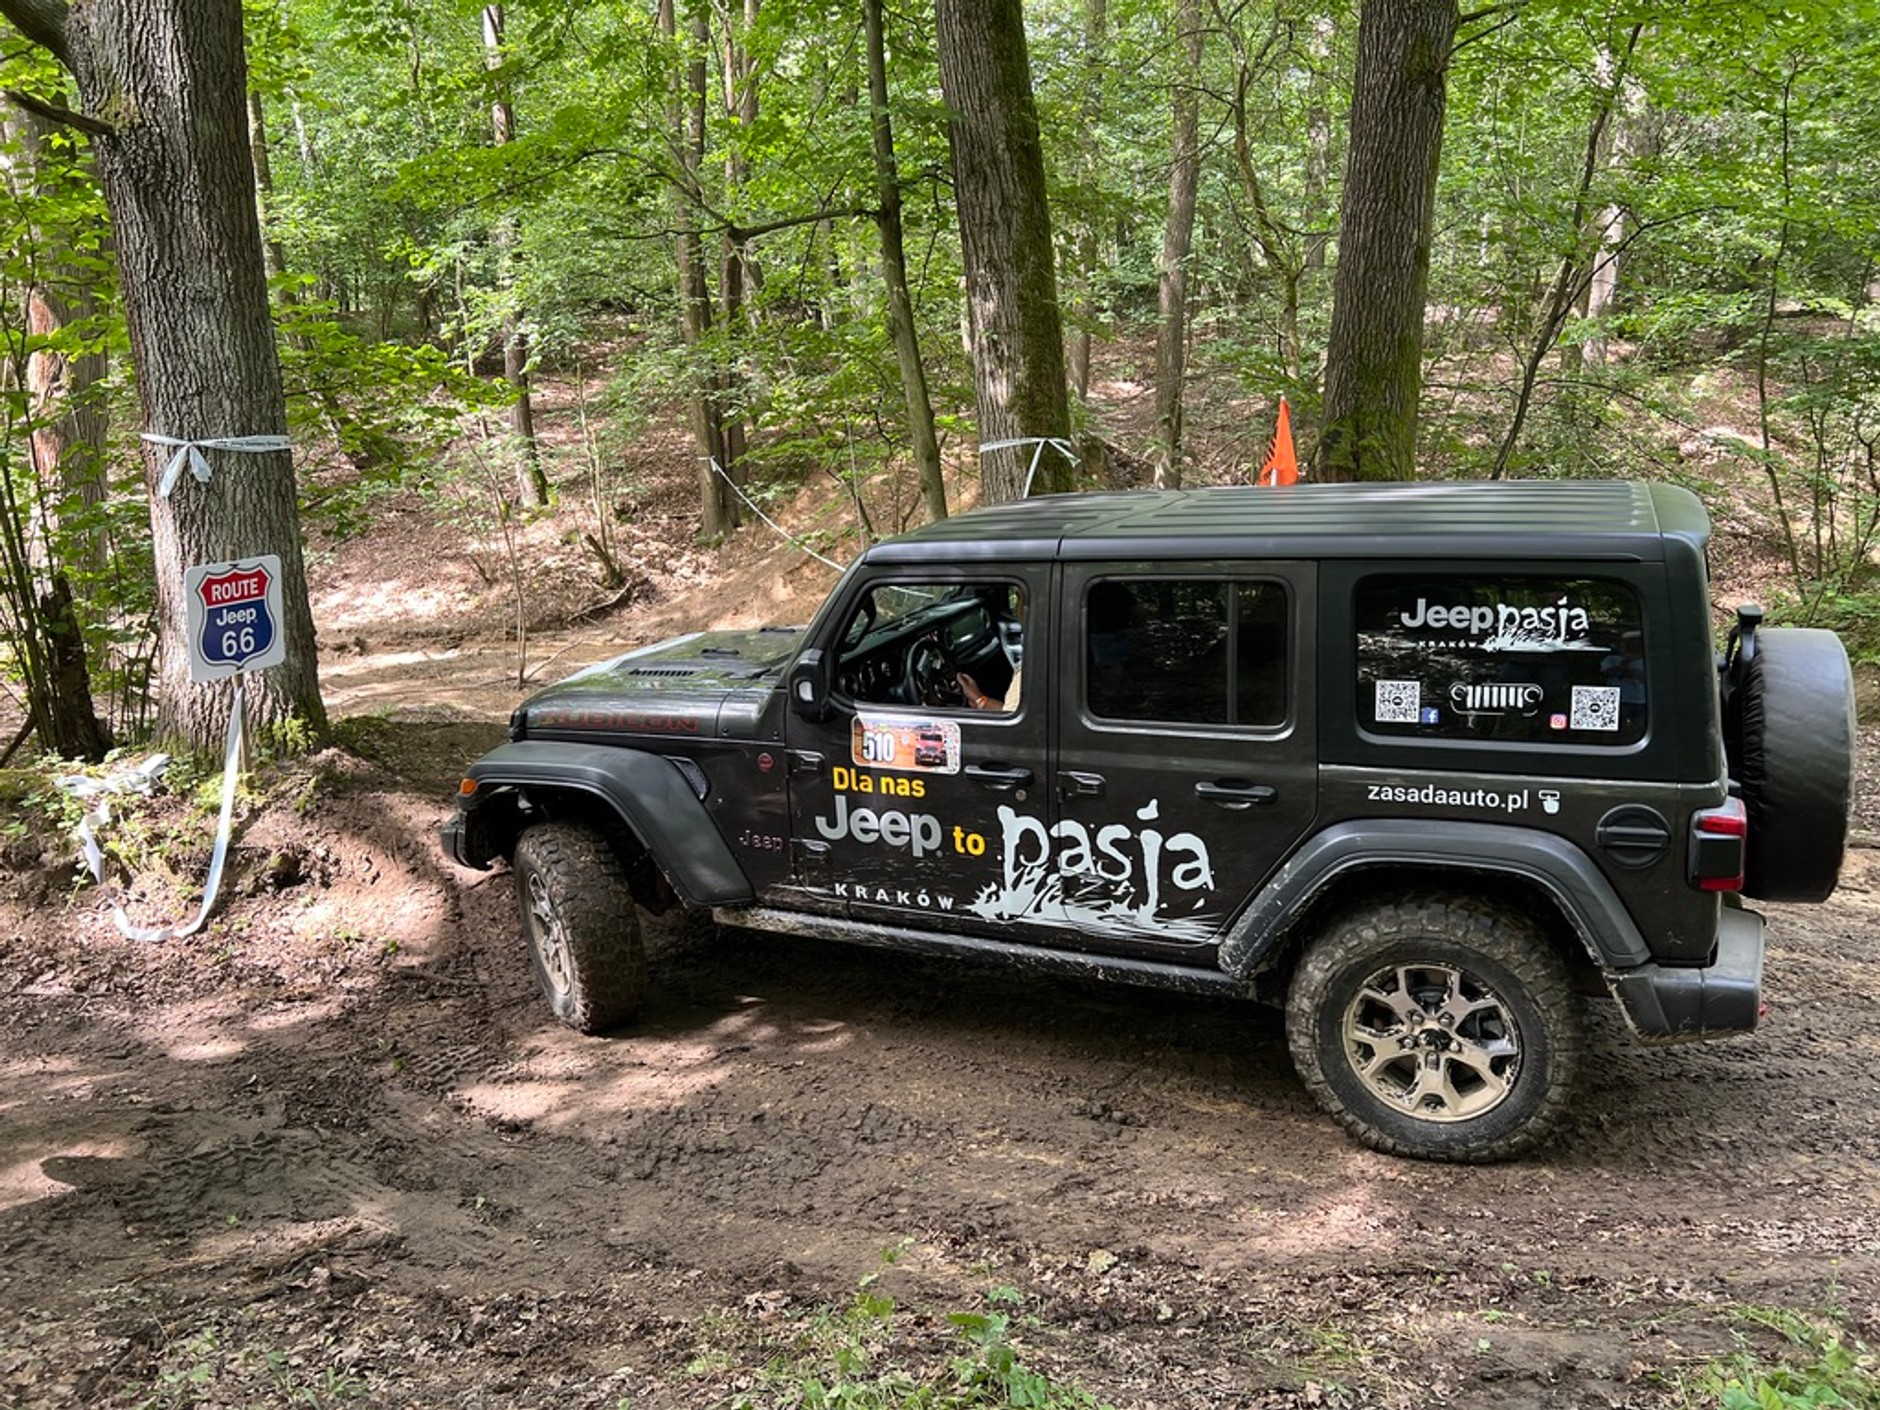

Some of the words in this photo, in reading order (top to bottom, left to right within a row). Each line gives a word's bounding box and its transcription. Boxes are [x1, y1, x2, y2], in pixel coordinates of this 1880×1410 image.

[211, 577, 260, 602] ROUTE
[215, 607, 258, 627] Jeep
[1400, 597, 1494, 635] Jeep
[1496, 595, 1590, 642] pasja
[221, 627, 256, 658] 66
[538, 707, 700, 733] RUBICON
[862, 730, 896, 764] 510
[832, 767, 874, 793] Dla
[879, 775, 926, 798] nas
[1367, 784, 1530, 813] zasadaauto.pl
[739, 829, 784, 854] Jeep
[814, 794, 943, 858] Jeep
[952, 825, 987, 856] to
[996, 798, 1216, 928] pasja
[834, 881, 956, 911] KRAKÓW
